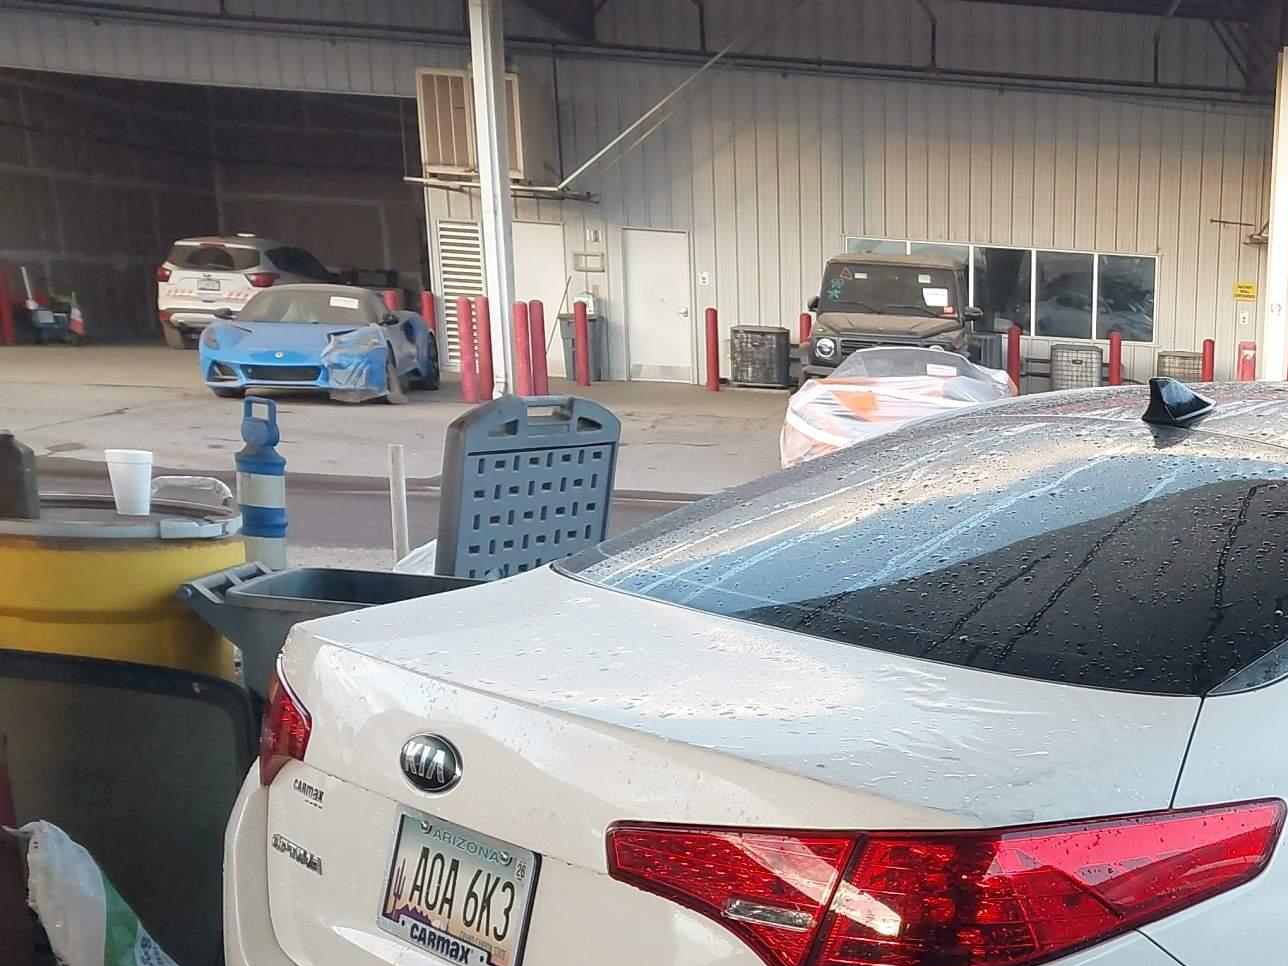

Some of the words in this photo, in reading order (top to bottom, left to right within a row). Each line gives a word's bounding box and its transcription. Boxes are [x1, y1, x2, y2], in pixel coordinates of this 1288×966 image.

[405, 741, 446, 783] KIA
[433, 829, 500, 864] ARIZONA
[515, 861, 527, 880] 26
[463, 869, 516, 942] 6K3
